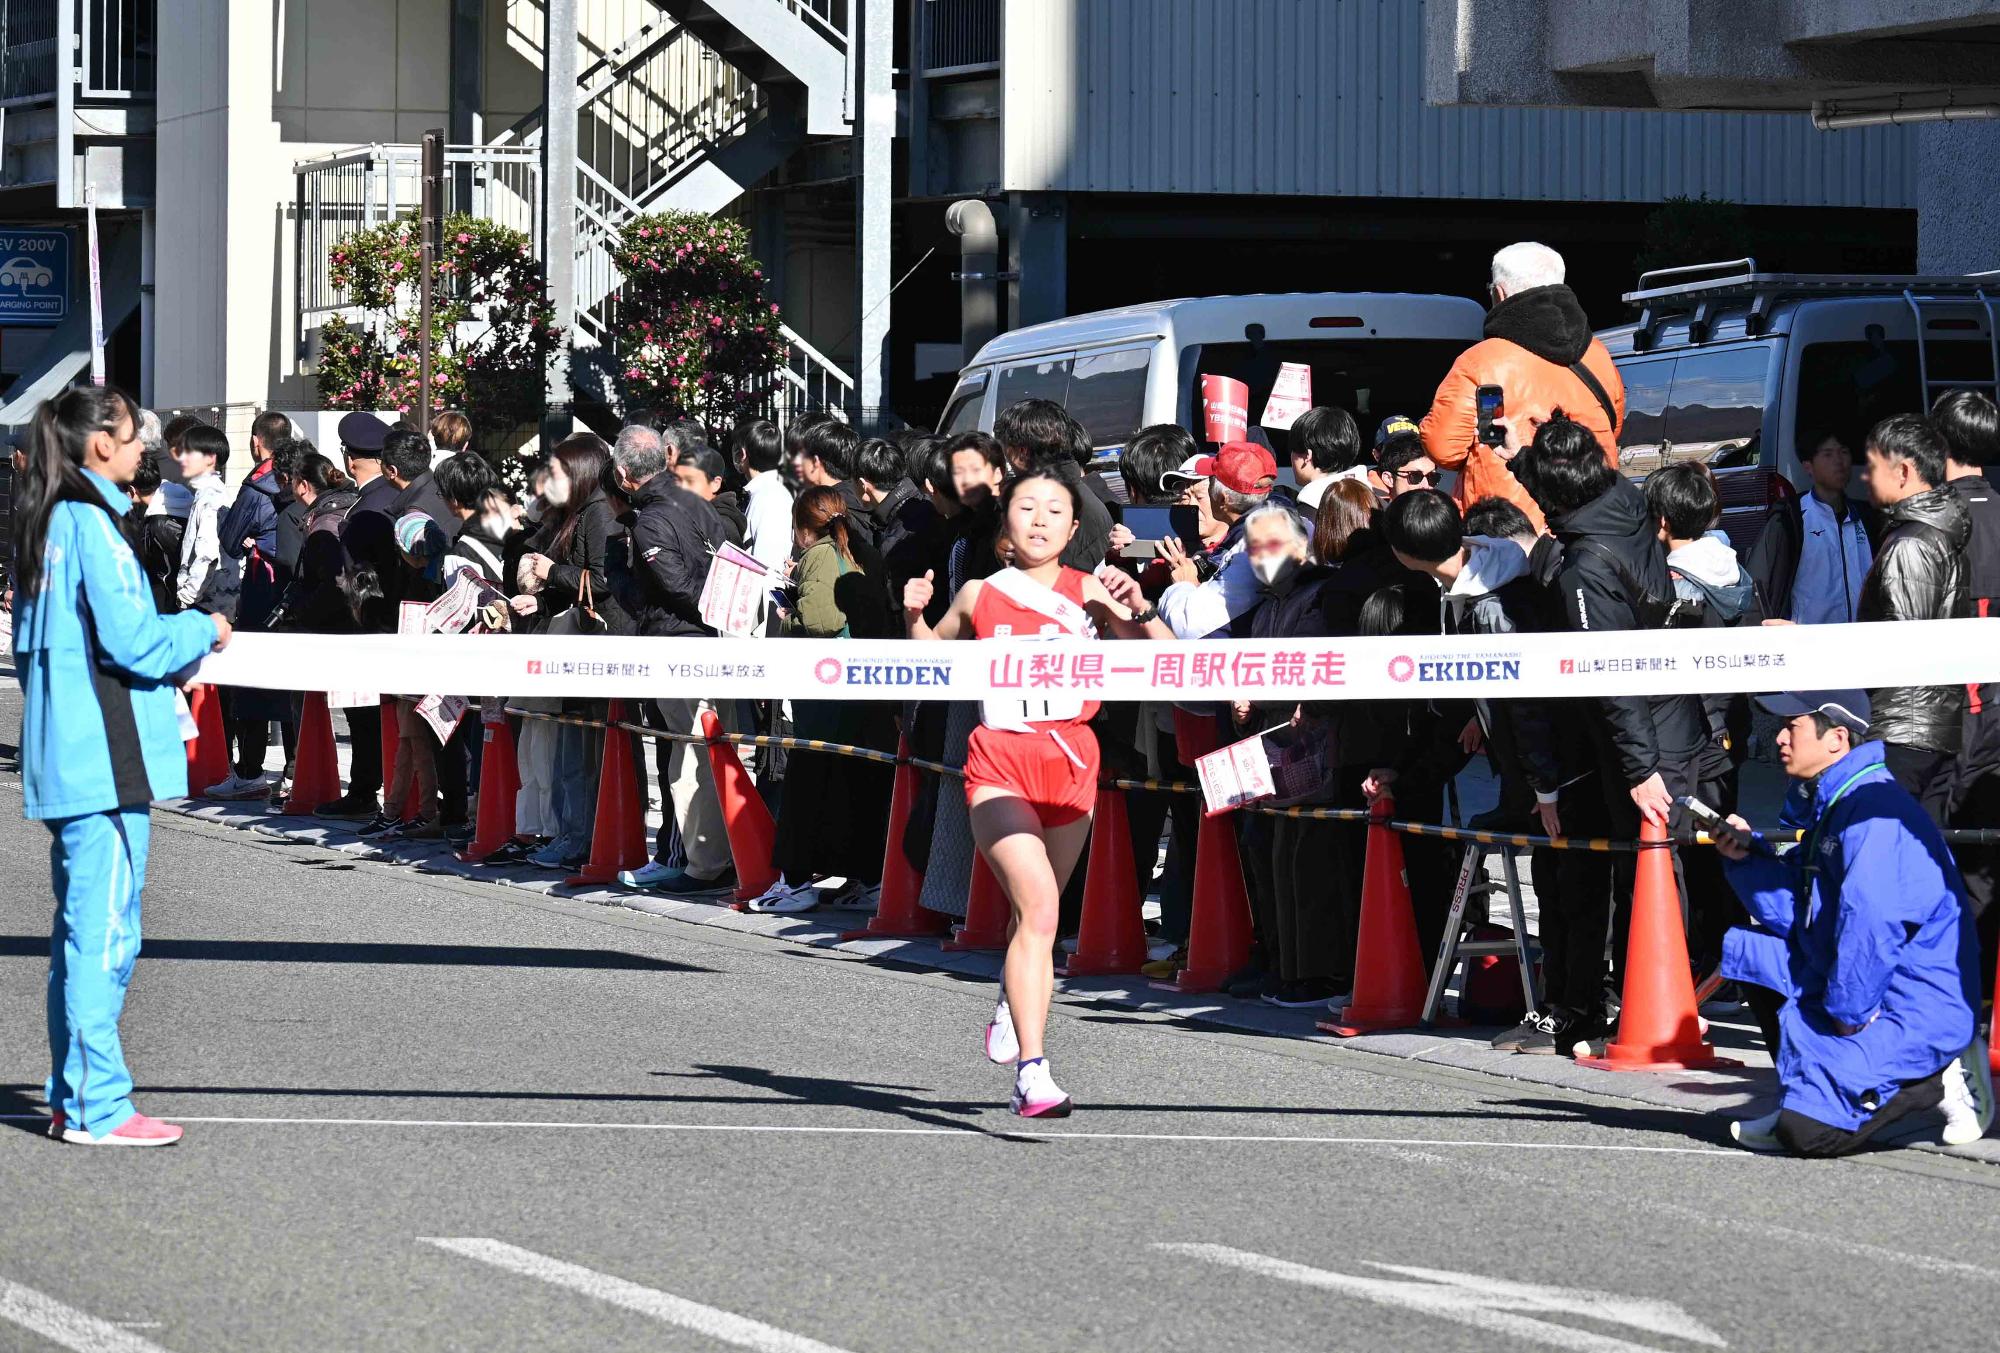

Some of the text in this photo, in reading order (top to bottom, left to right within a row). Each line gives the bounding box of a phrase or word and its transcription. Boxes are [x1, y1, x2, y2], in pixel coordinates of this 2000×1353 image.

[18, 239, 56, 252] 200V
[34, 301, 59, 309] POINT
[1576, 588, 1589, 630] ARMOUR
[545, 661, 766, 678] 山梨日日新聞社 YBS山梨放送
[989, 650, 1346, 689] 山梨県一周駅伝競走
[1418, 660, 1521, 682] EKIDEN
[1577, 653, 1786, 674] 山梨日日新聞社 YBS山梨放送
[846, 665, 952, 686] EKIDEN
[1452, 868, 1469, 912] PRESS
